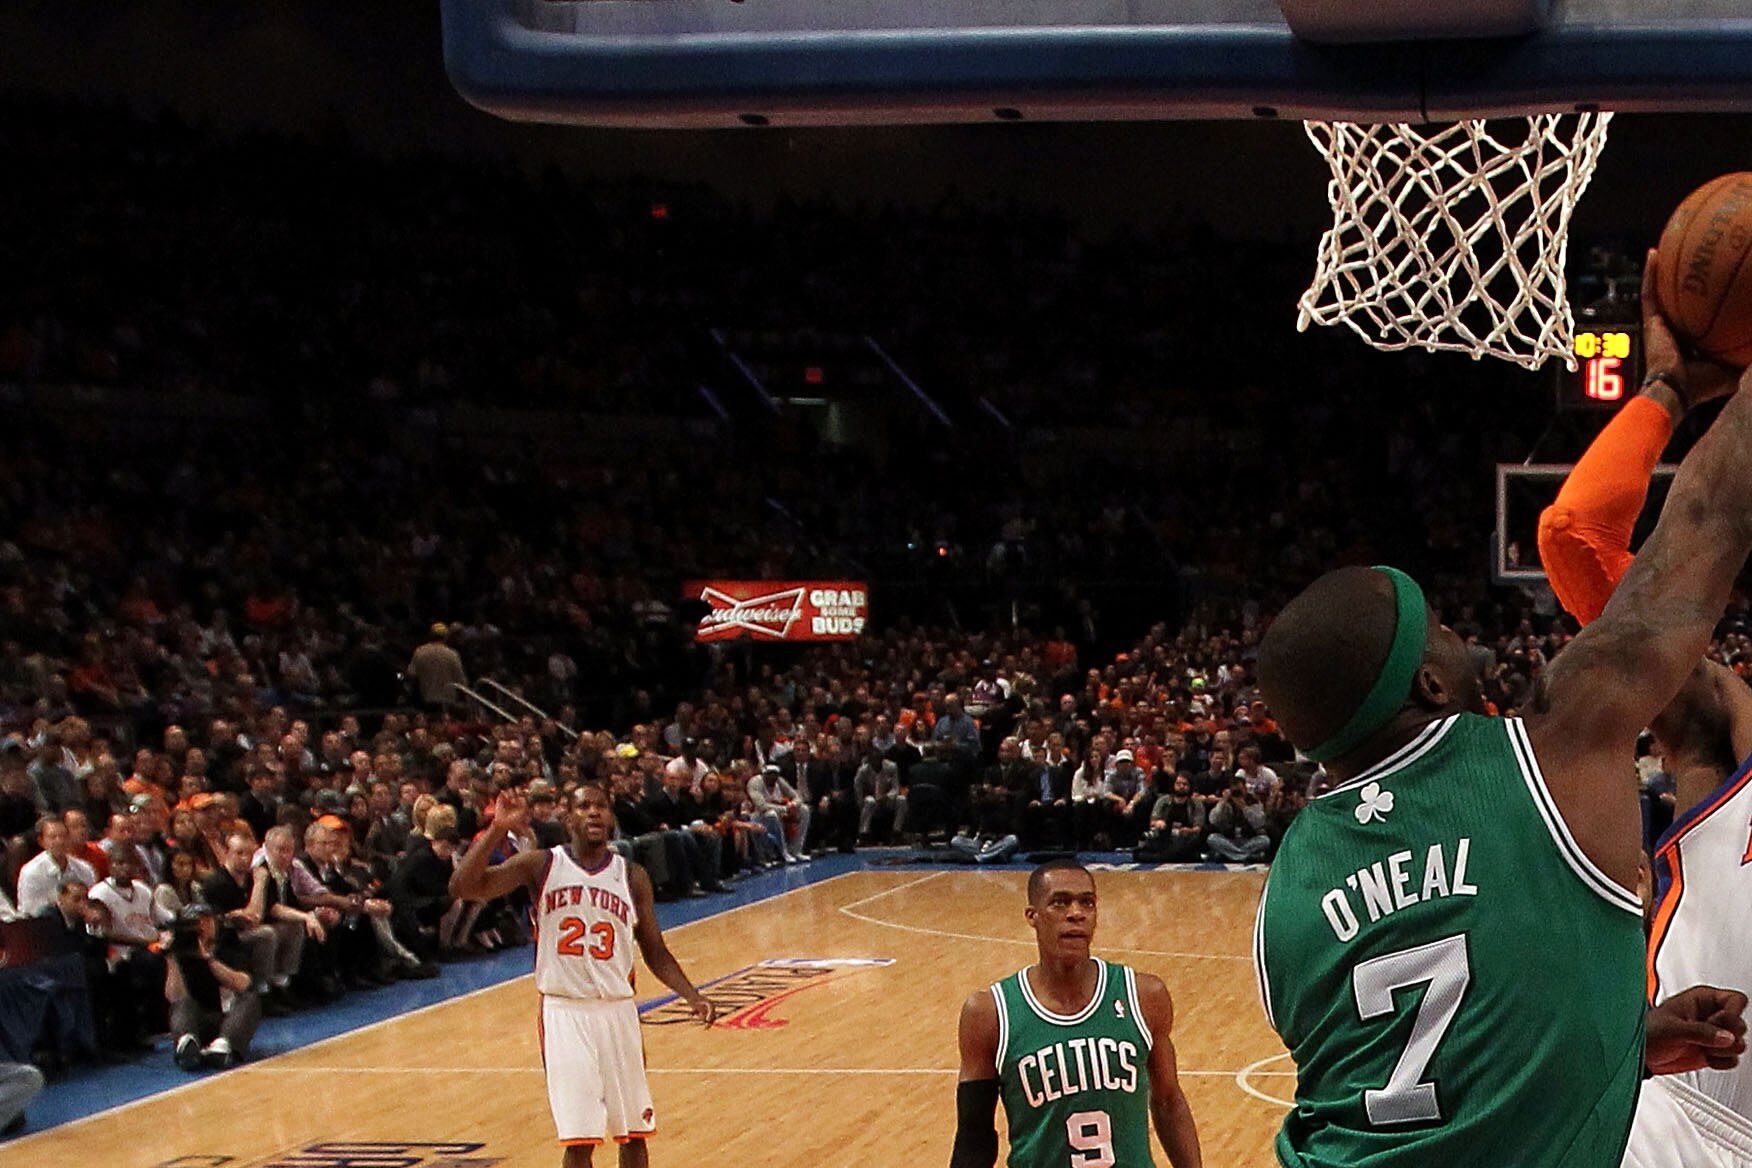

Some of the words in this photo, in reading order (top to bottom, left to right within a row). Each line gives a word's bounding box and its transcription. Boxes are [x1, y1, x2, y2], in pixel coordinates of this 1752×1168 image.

[1586, 358, 1624, 400] 16
[711, 600, 803, 623] udweiser
[810, 590, 866, 607] GRAB
[545, 885, 584, 915] NEW
[588, 886, 630, 928] YORK
[1321, 837, 1478, 943] O'NEAL
[557, 916, 615, 960] 23
[1353, 933, 1470, 1126] 7
[1017, 1036, 1138, 1109] CELTICS
